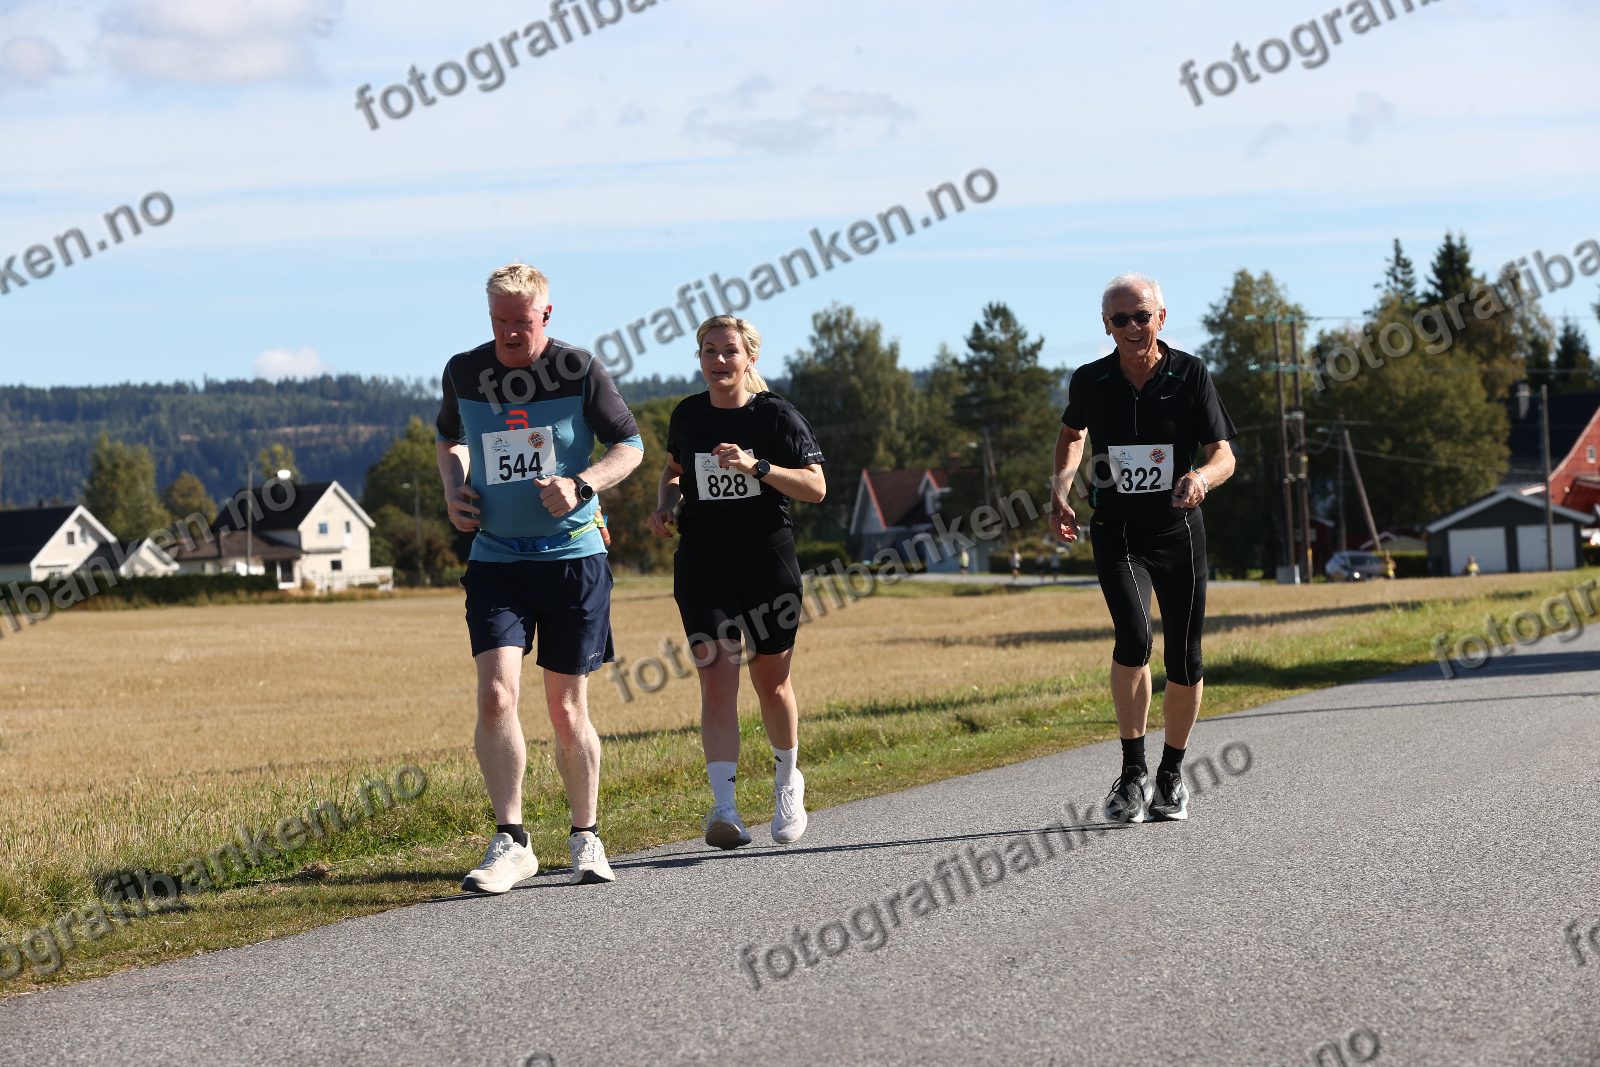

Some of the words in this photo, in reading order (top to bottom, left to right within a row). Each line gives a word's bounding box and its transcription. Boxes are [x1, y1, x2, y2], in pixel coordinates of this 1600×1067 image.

[499, 452, 542, 480] 544
[707, 474, 748, 497] 828
[1121, 467, 1161, 491] 322
